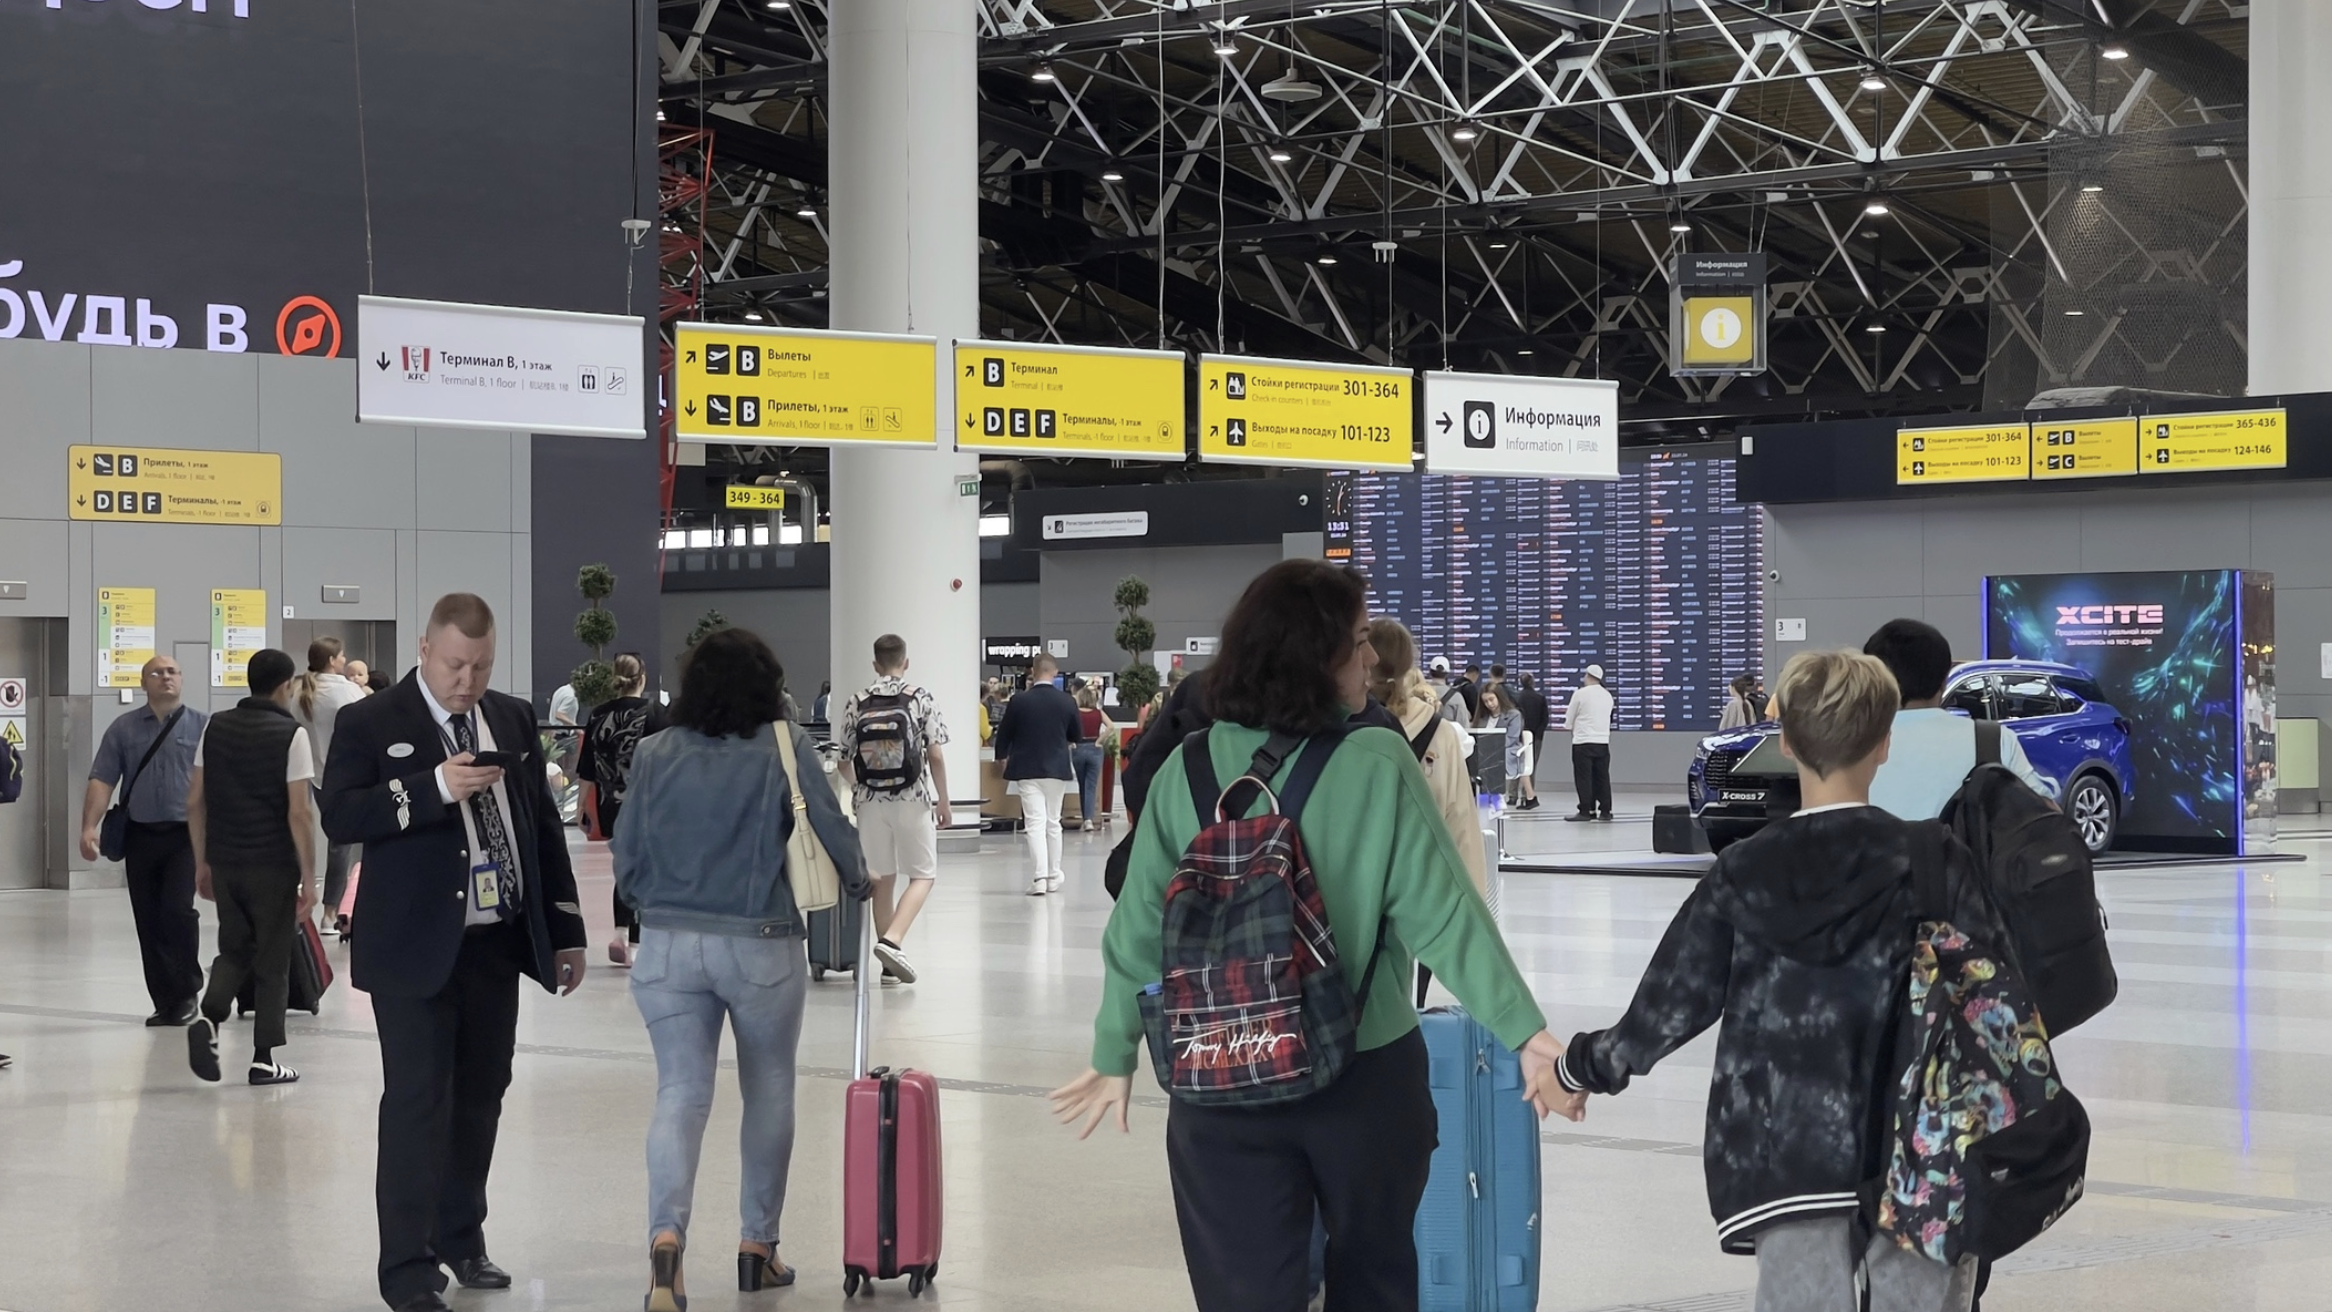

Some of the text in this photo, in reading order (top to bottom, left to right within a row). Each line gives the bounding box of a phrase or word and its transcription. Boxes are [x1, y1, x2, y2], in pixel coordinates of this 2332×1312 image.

[1696, 261, 1748, 269] Информация
[440, 351, 552, 371] Терминал B, 1 этаж
[741, 350, 755, 371] B
[768, 349, 811, 362] Вылеты
[767, 368, 807, 380] Departures
[987, 362, 1000, 383] B
[1011, 362, 1058, 376] Терминал
[408, 373, 426, 381] KFC
[440, 374, 516, 389] Terminal B, 1 floor
[1011, 380, 1038, 390] Terminal
[1252, 376, 1399, 398] Стойки регистрации 301-364
[742, 401, 756, 422] B
[768, 399, 849, 414] Прилеты, 1 этаж
[987, 411, 1051, 434] D E F
[1063, 413, 1117, 427] Терминалы,
[1126, 419, 1141, 427] этаж
[1505, 407, 1601, 429] Информация
[2236, 418, 2276, 429] 365-436
[767, 419, 798, 430] Arrivals,
[803, 420, 821, 430] floor
[1100, 433, 1114, 442] floor
[1252, 422, 1390, 443] Выходы на посадку 101-123
[1985, 432, 2022, 443] 301-364
[2064, 432, 2073, 443] B
[1506, 437, 1563, 452] Information
[2234, 445, 2272, 455] 124-146
[122, 458, 133, 474] B
[143, 458, 185, 470] Прилеты,
[1986, 456, 2021, 466] 101-123
[2064, 456, 2073, 467] C
[97, 493, 157, 510] D E F
[168, 494, 219, 506] Терминалы,
[730, 491, 750, 503] 349
[759, 492, 780, 504] 364
[102, 606, 107, 615] 3
[215, 608, 220, 616] 3
[2056, 605, 2163, 625] XCITE
[1778, 621, 1784, 631] 3
[2108, 628, 2139, 636] реальной
[2066, 638, 2105, 646] Запишитесь
[2116, 638, 2152, 646] тест-драйв
[988, 642, 1031, 658] wrapping
[1722, 791, 1765, 801] X-CROSS 7
